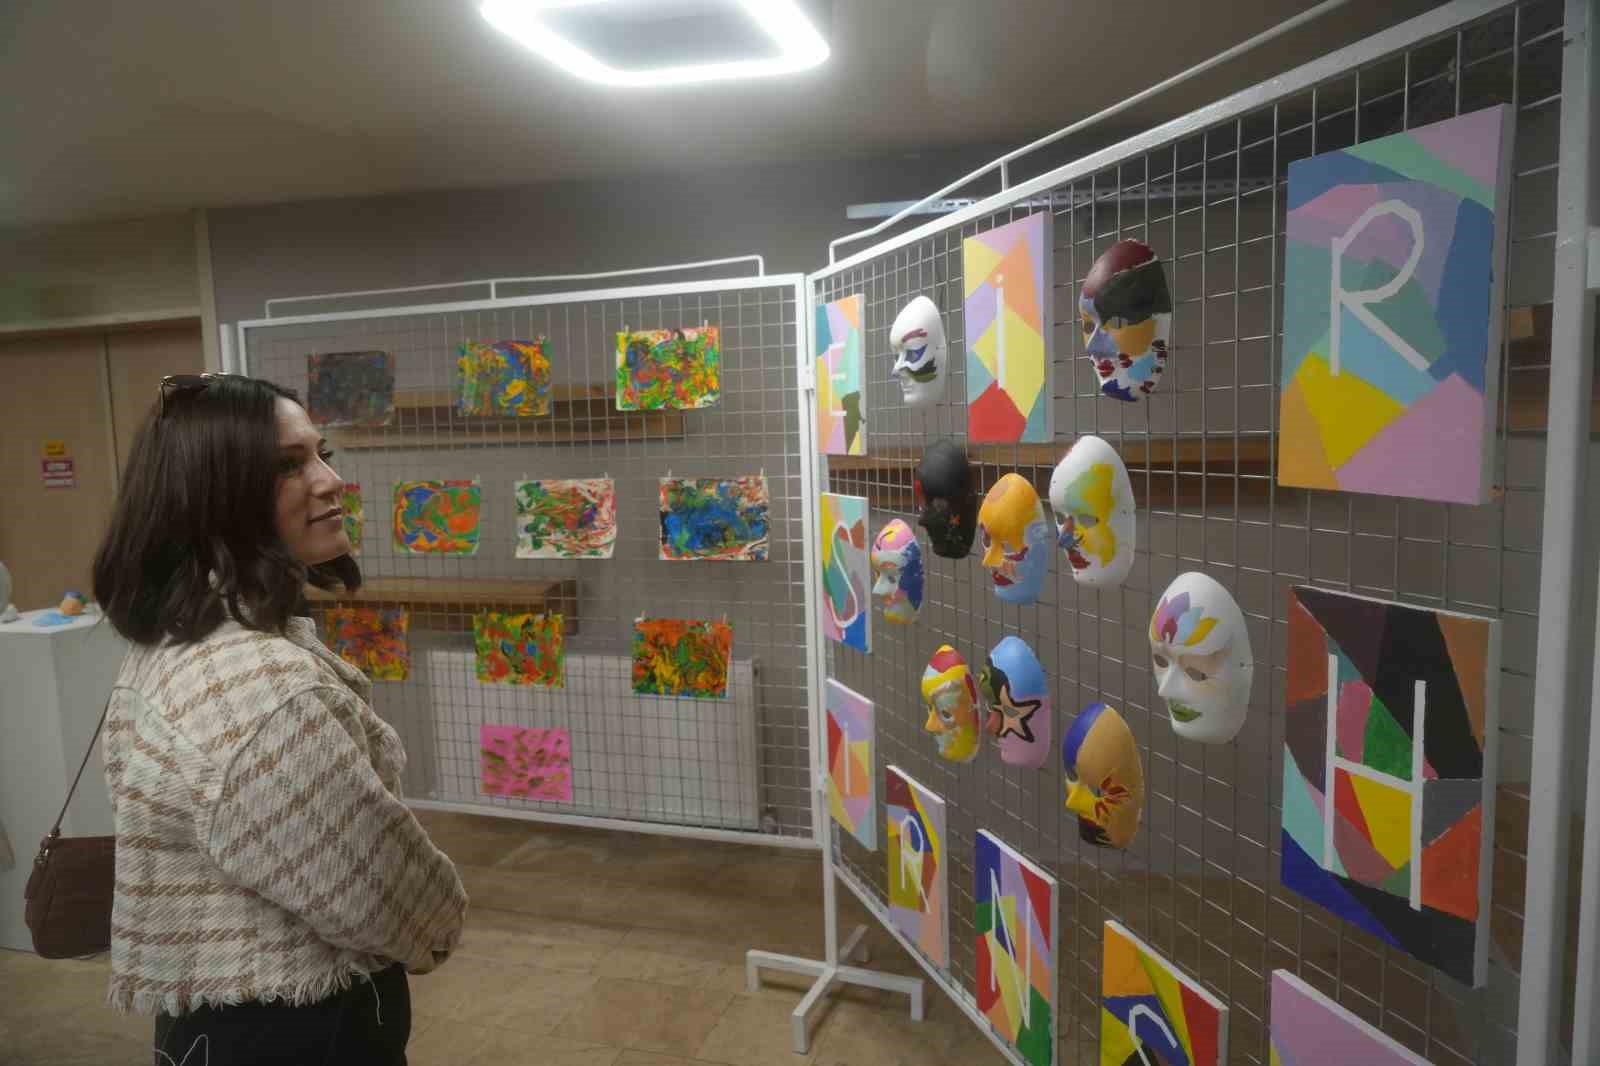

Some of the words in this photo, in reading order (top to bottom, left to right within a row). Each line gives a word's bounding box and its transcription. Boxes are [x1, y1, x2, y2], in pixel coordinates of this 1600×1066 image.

[1330, 199, 1431, 377] R
[828, 341, 848, 417] E
[1323, 653, 1427, 912] H
[899, 815, 931, 915] R
[989, 867, 1032, 1031] N
